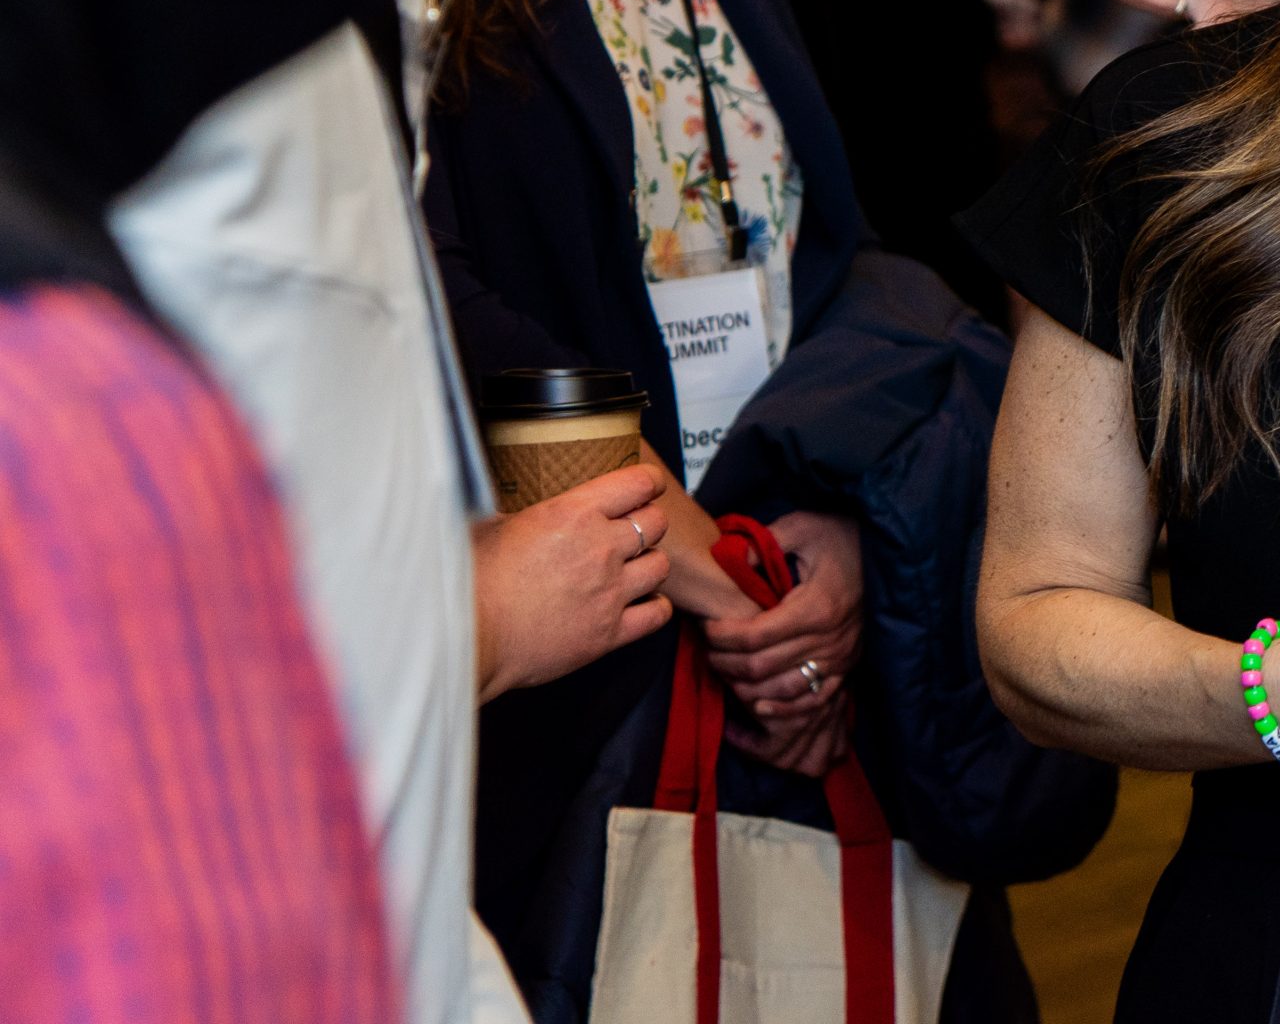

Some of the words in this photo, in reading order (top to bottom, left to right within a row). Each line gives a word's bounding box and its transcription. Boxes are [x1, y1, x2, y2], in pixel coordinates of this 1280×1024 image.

[659, 310, 750, 339] TINATION
[671, 335, 729, 361] UMMIT
[682, 427, 723, 449] bec
